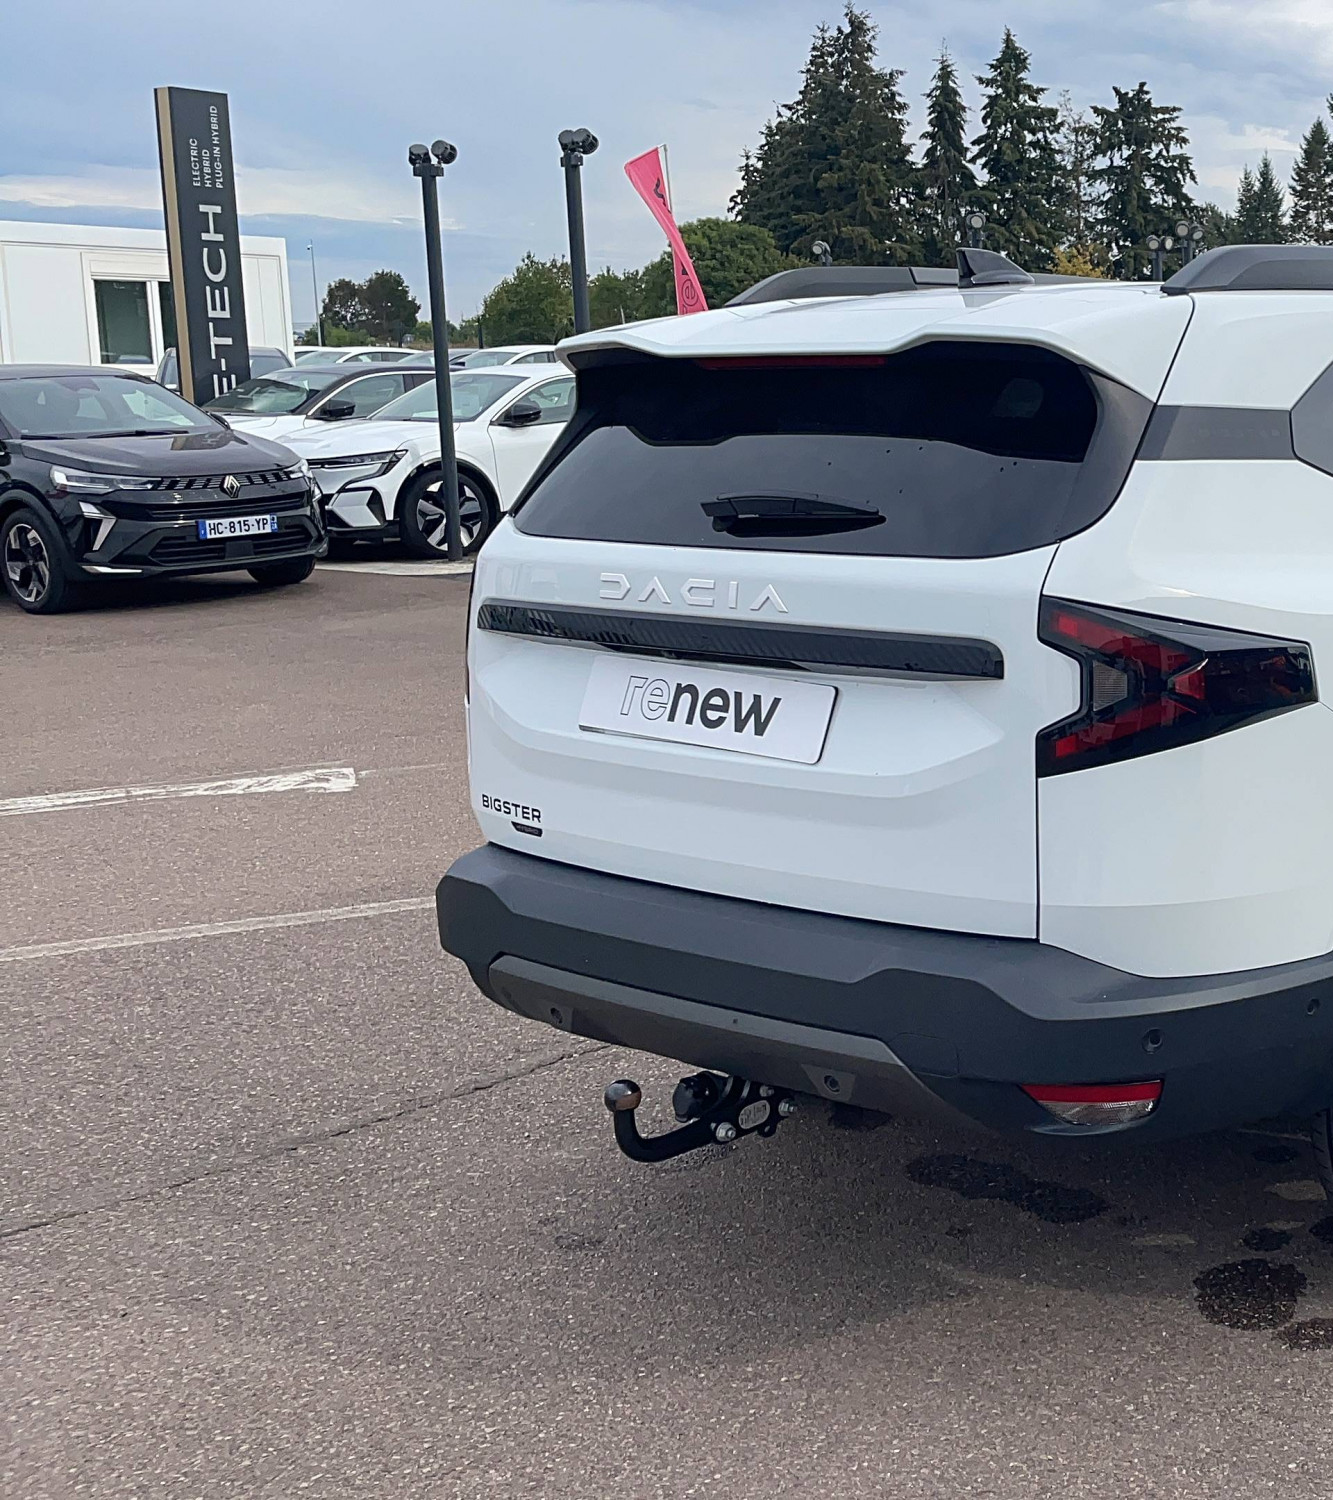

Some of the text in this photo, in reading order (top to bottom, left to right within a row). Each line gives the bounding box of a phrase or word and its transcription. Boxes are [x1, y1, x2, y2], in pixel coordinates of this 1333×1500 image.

[189, 138, 201, 187] ELECTRIC
[202, 149, 212, 188] HYBRID
[209, 105, 224, 189] PLUG-IN HYBRID
[199, 204, 238, 399] E-TECH
[208, 517, 269, 536] HC-815-YP
[599, 572, 789, 614] DACIA
[619, 675, 783, 737] renew
[481, 793, 542, 824] BIGSTER
